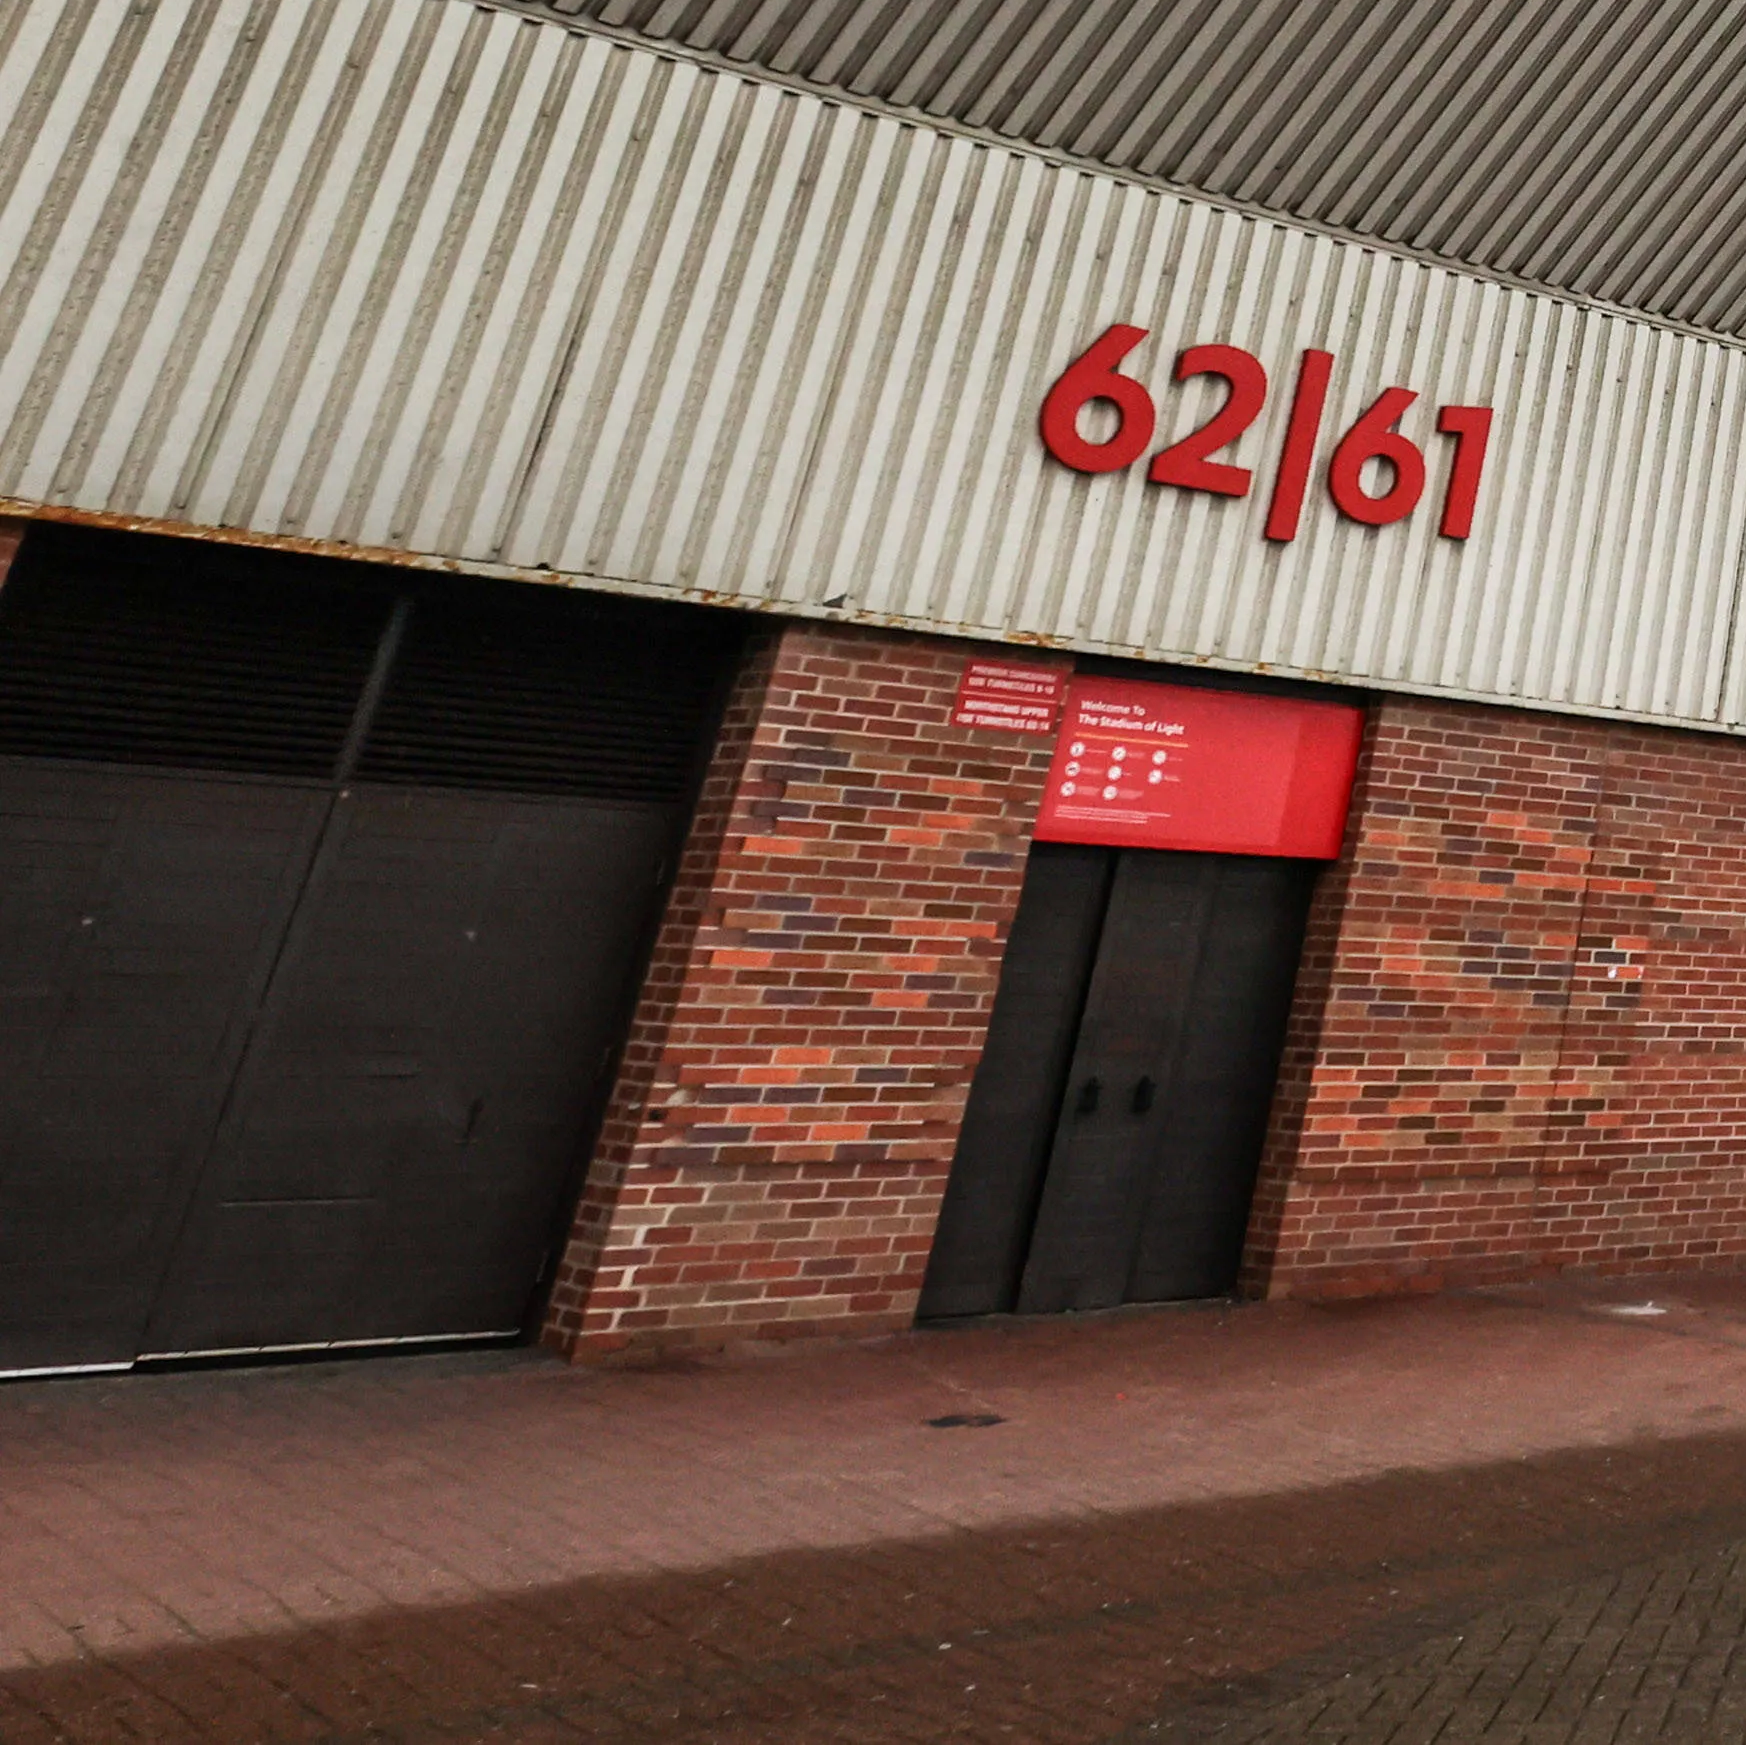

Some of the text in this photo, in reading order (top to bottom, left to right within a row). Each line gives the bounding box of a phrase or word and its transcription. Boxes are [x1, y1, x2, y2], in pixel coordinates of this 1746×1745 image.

[1081, 700, 1146, 716] Welcome To
[1079, 713, 1099, 726] The
